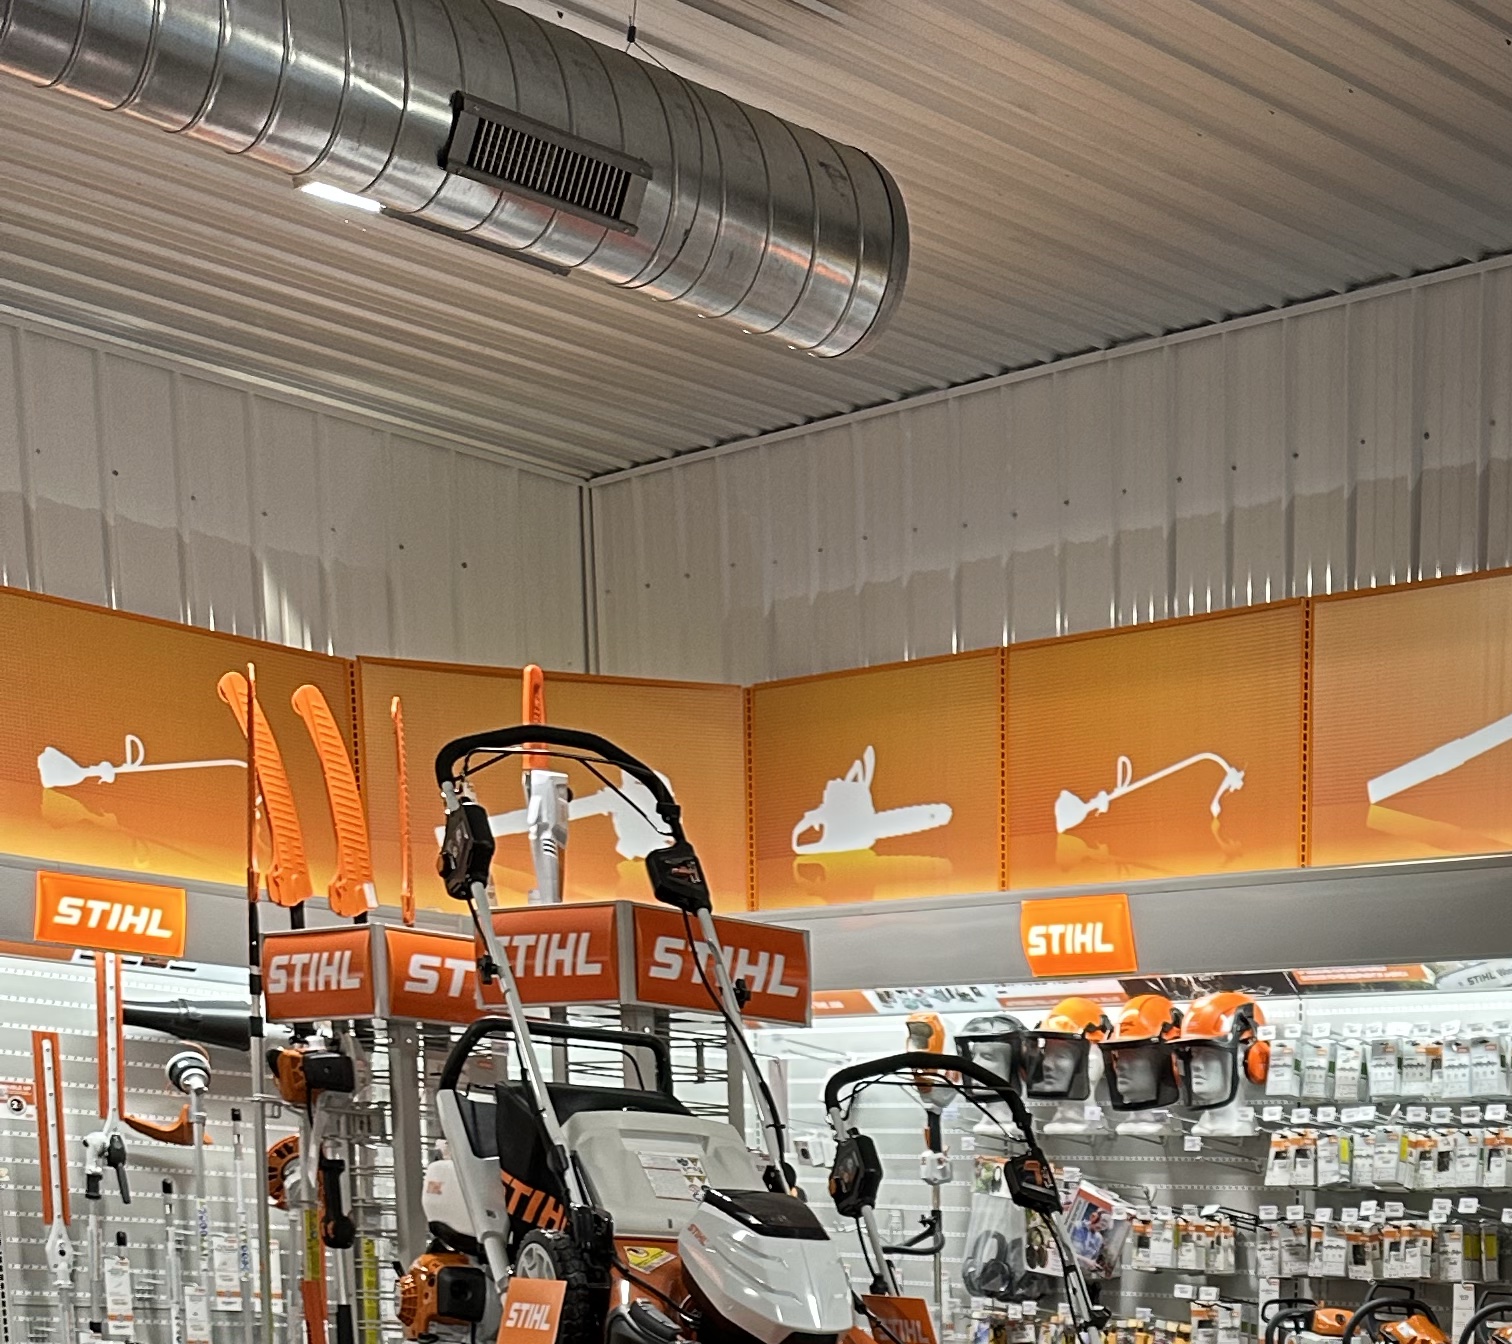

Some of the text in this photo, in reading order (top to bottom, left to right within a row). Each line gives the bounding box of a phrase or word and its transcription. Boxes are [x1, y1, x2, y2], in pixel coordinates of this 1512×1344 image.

[53, 896, 173, 939] STIHL
[1027, 922, 1114, 956] STIHL
[268, 950, 365, 994] STIHL
[497, 932, 602, 977] TIHL
[648, 936, 800, 998] STIHL
[506, 1302, 550, 1330] STIHL
